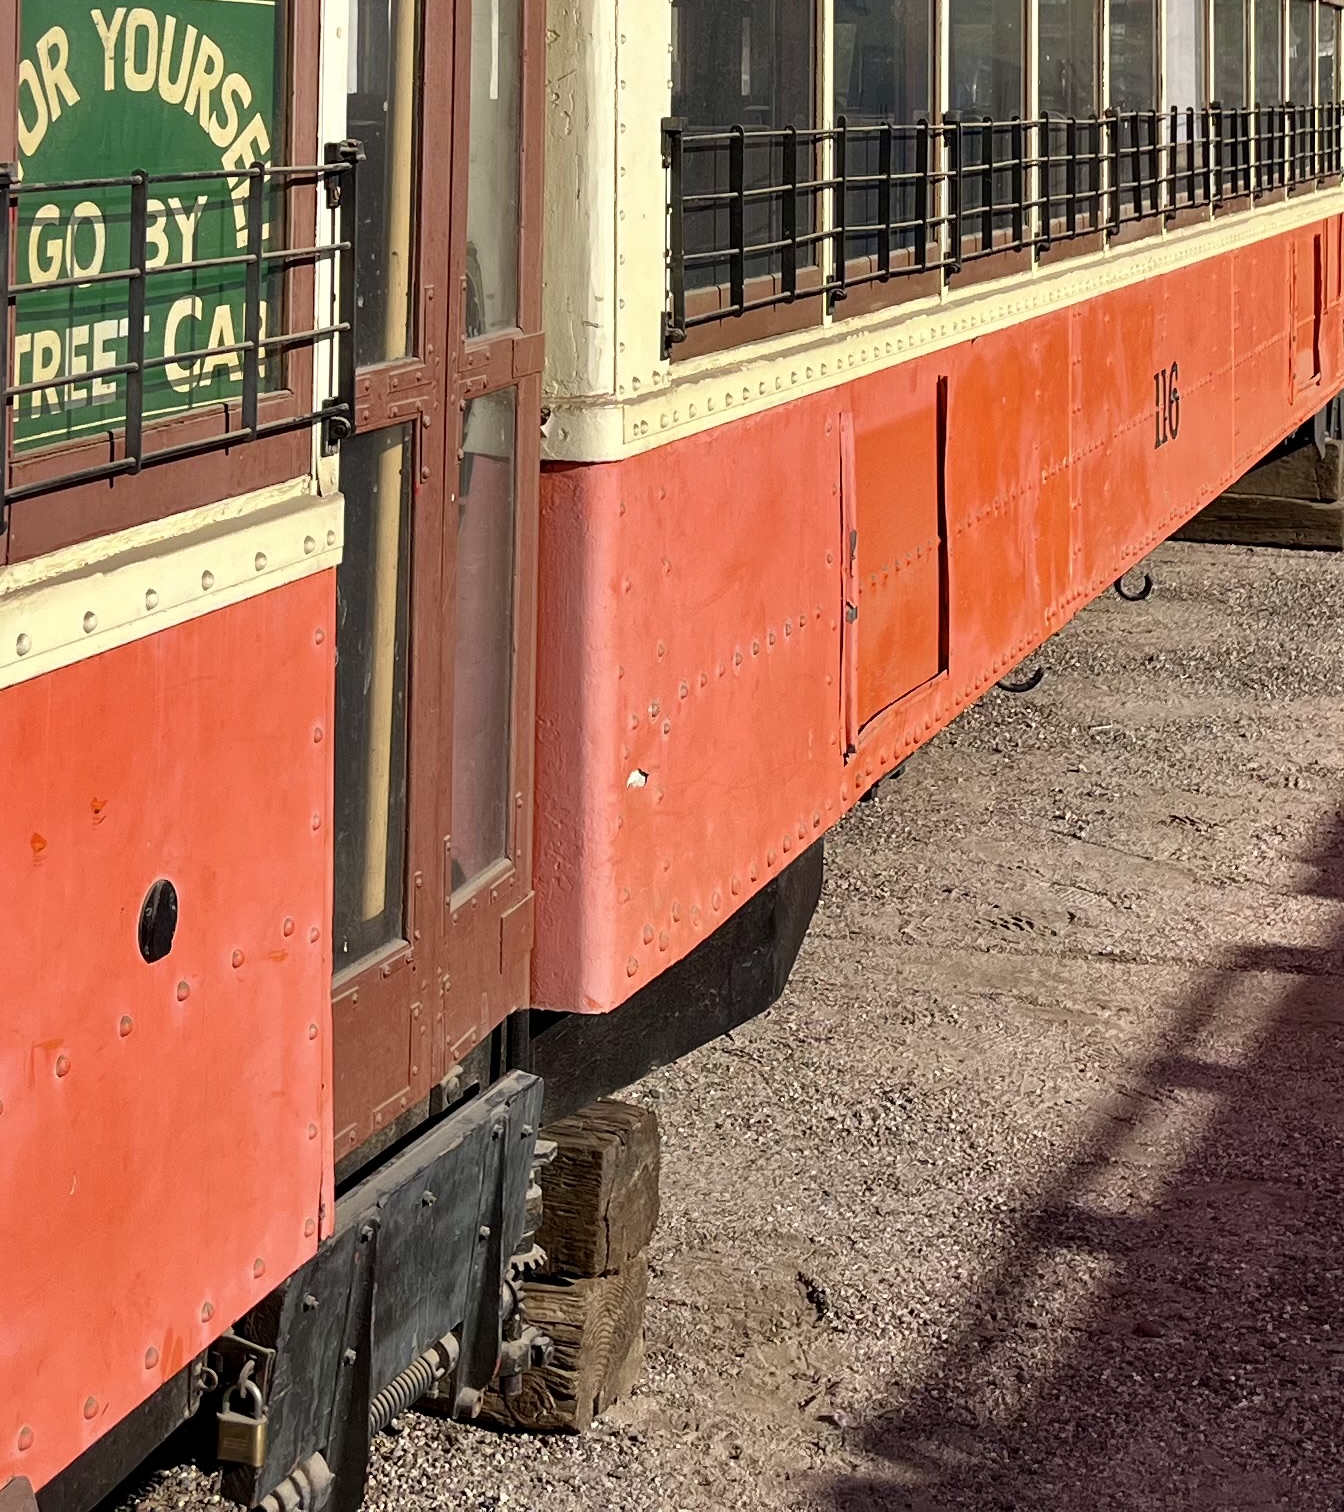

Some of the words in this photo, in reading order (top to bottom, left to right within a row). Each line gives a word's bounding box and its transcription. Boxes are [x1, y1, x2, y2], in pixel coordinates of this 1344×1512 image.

[18, 26, 81, 181] OR
[28, 201, 106, 292] GO
[144, 195, 208, 271] BY
[1153, 360, 1180, 450] 116
